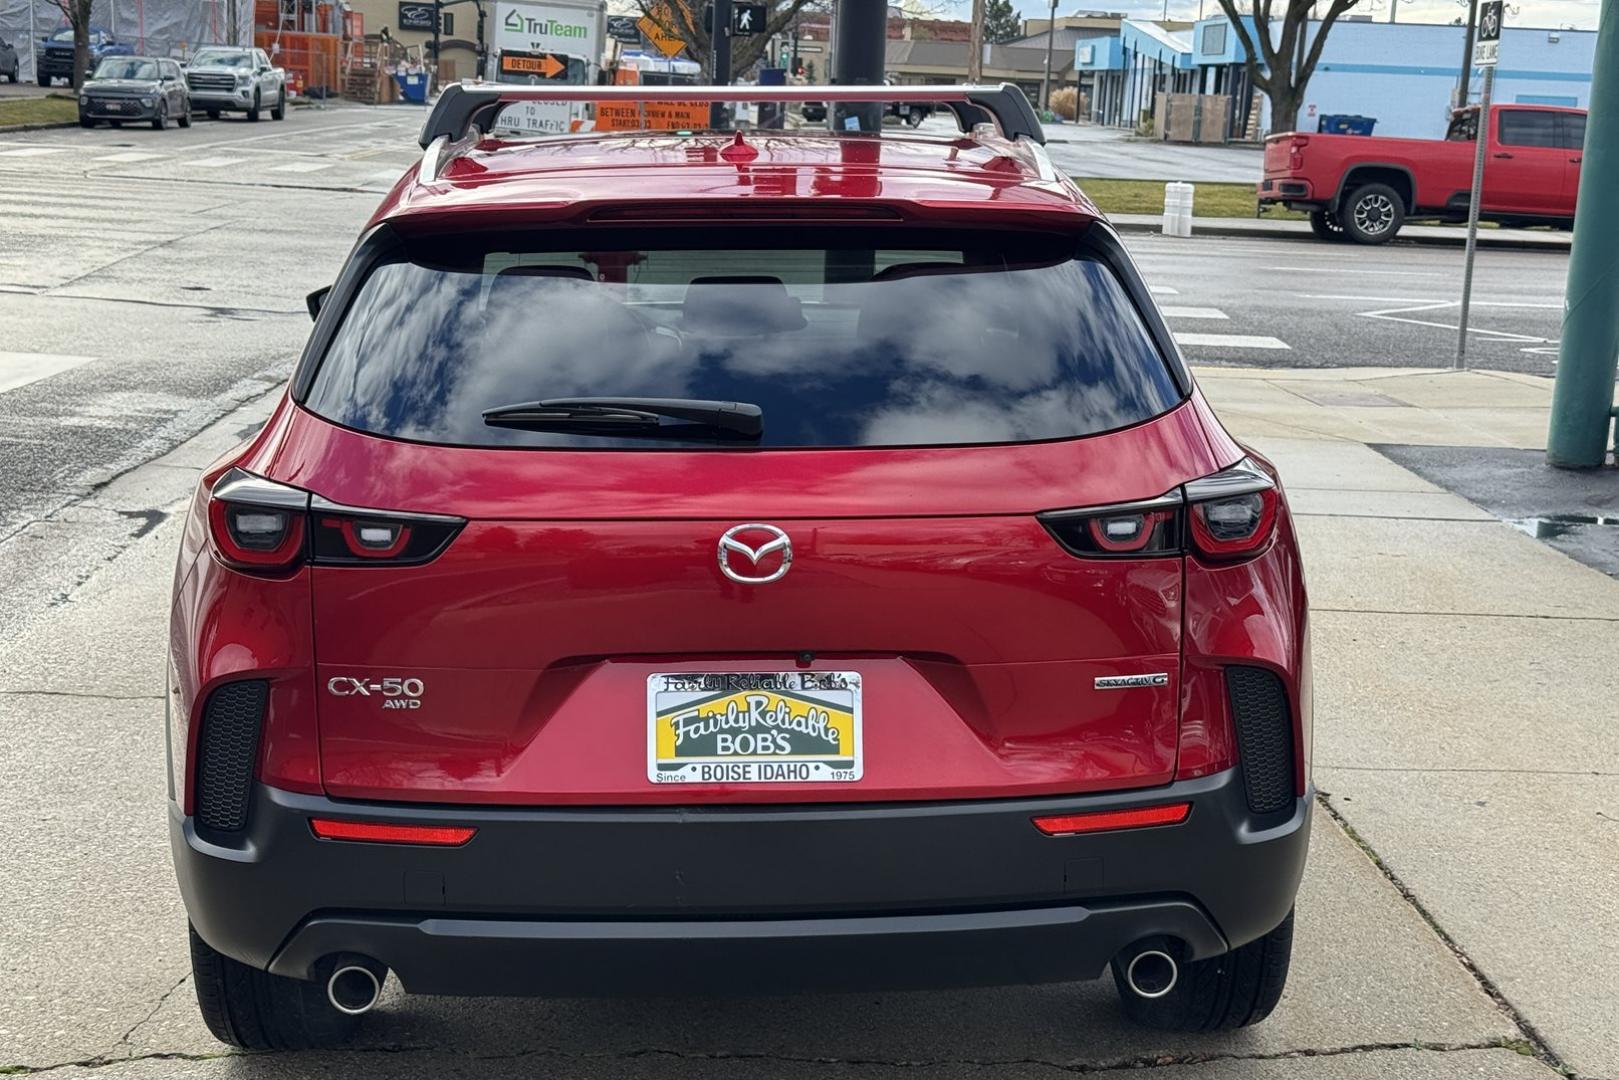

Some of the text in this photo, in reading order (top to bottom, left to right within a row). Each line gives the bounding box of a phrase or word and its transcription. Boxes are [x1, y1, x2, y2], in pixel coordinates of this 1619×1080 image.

[525, 17, 587, 38] TruTeam
[511, 59, 542, 70] DETOUR
[526, 106, 536, 115] TO
[600, 107, 636, 117] BETWEEN
[674, 111, 691, 119] MAIN
[500, 116, 520, 127] HRU
[328, 677, 424, 697] CX-50
[726, 673, 796, 691] Reliable
[382, 699, 421, 709] AWD
[716, 729, 792, 756] BOB'S
[656, 763, 856, 782] Since BOISE IDAHO 1975
